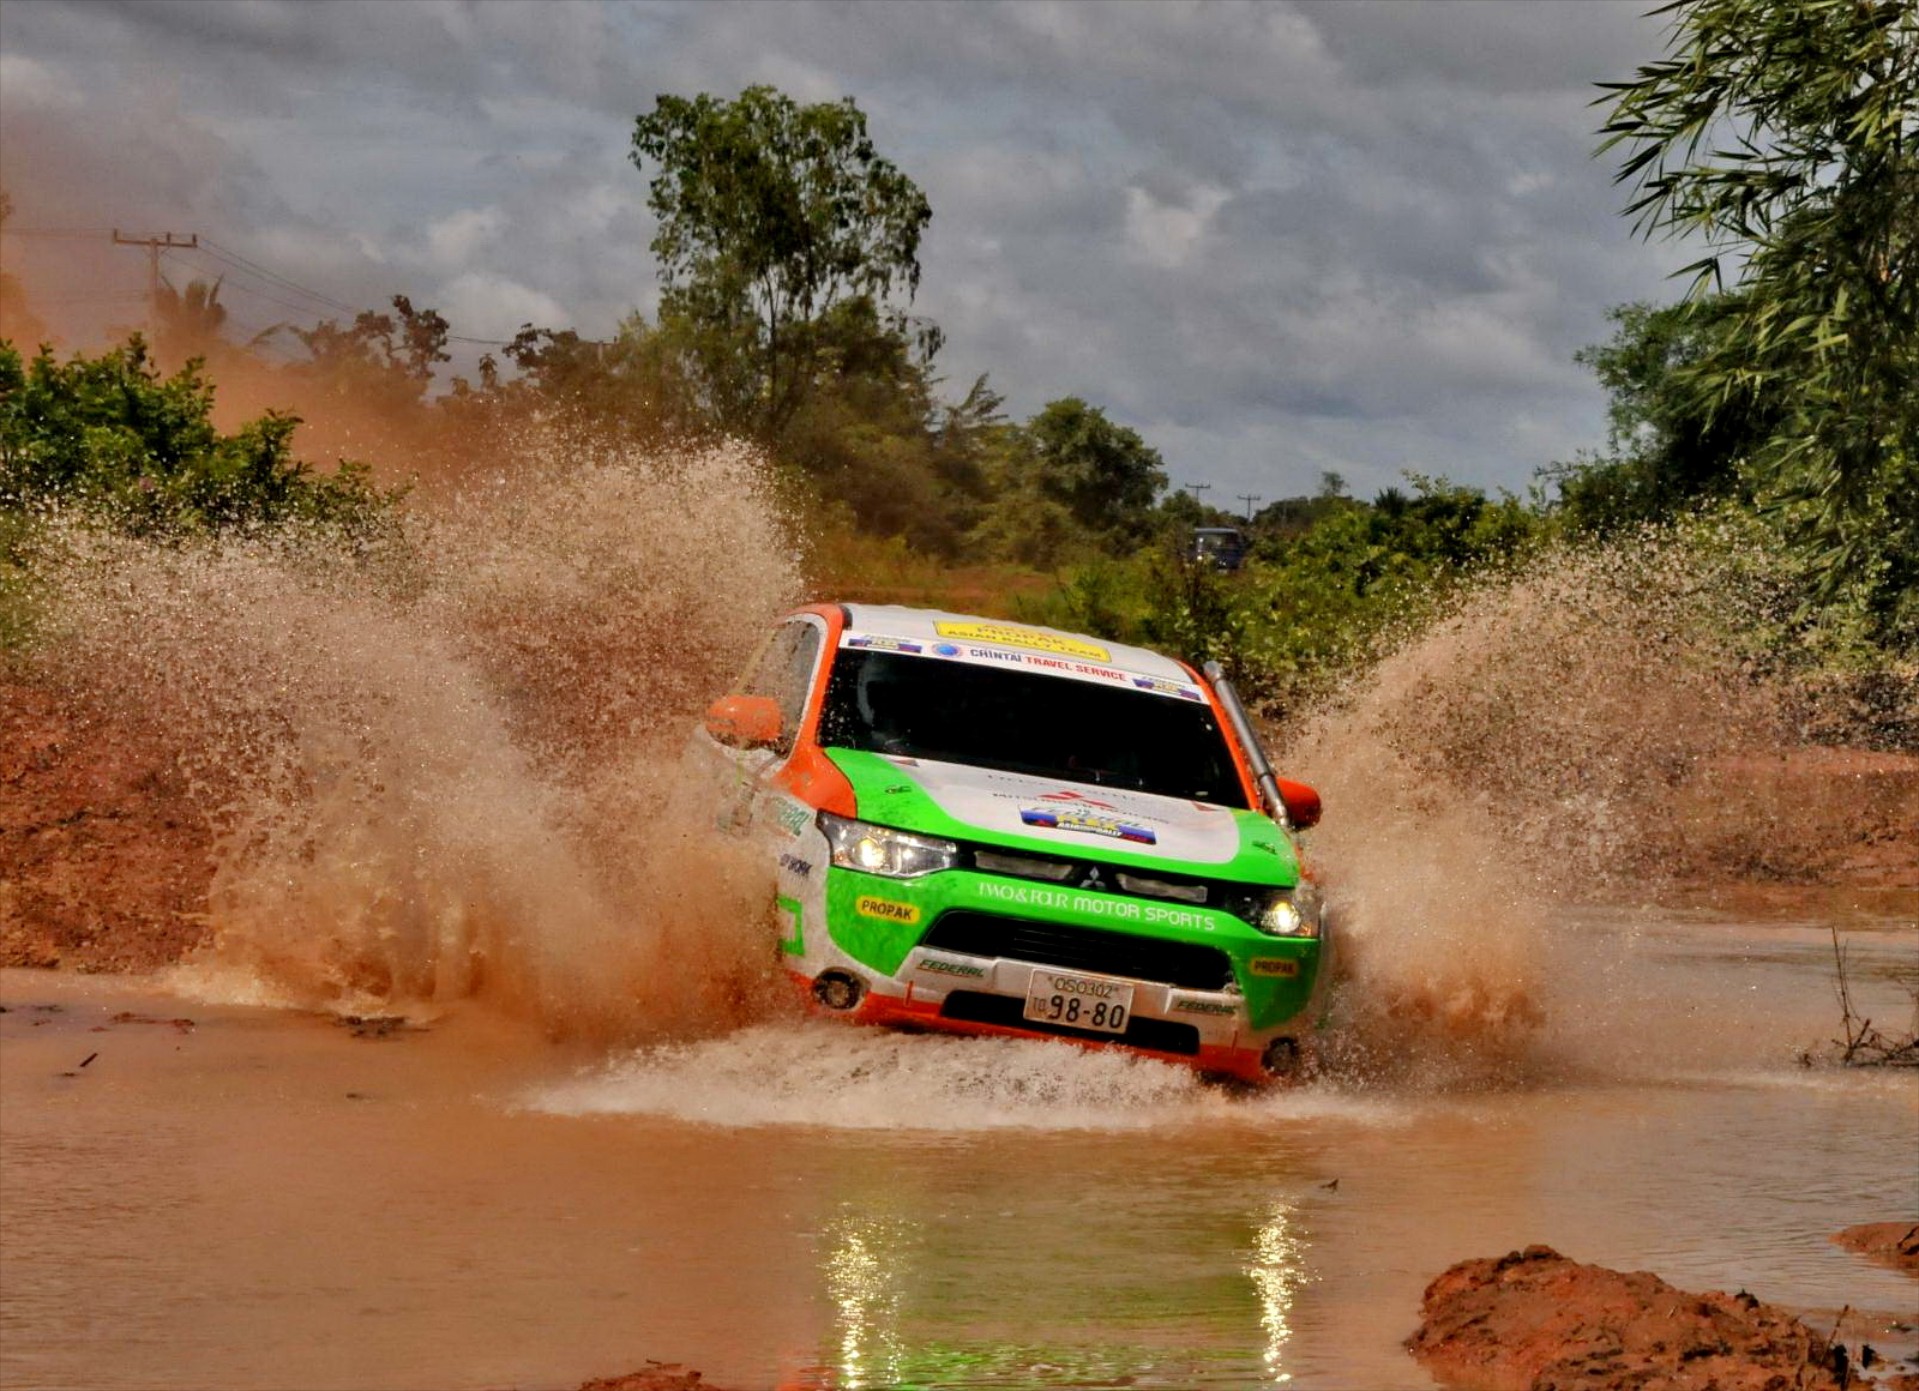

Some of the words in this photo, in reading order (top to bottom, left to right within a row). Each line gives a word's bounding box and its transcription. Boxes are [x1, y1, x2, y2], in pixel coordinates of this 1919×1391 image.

[948, 629, 997, 641] ASIAN
[1001, 636, 1052, 649] RALLY
[1059, 646, 1102, 659] TEAM
[970, 648, 1022, 662] CHINTAI
[1026, 656, 1072, 671] TRAVEL
[1075, 665, 1127, 682] SERVICE
[861, 899, 913, 920] PROPAK
[1073, 896, 1140, 919] MOTOR
[1144, 907, 1216, 931] SPORTS
[920, 959, 985, 978] FEDERAL
[1254, 960, 1295, 974] PROPAK
[1047, 994, 1126, 1029] 98-80
[1177, 1000, 1237, 1015] FEDERAL
